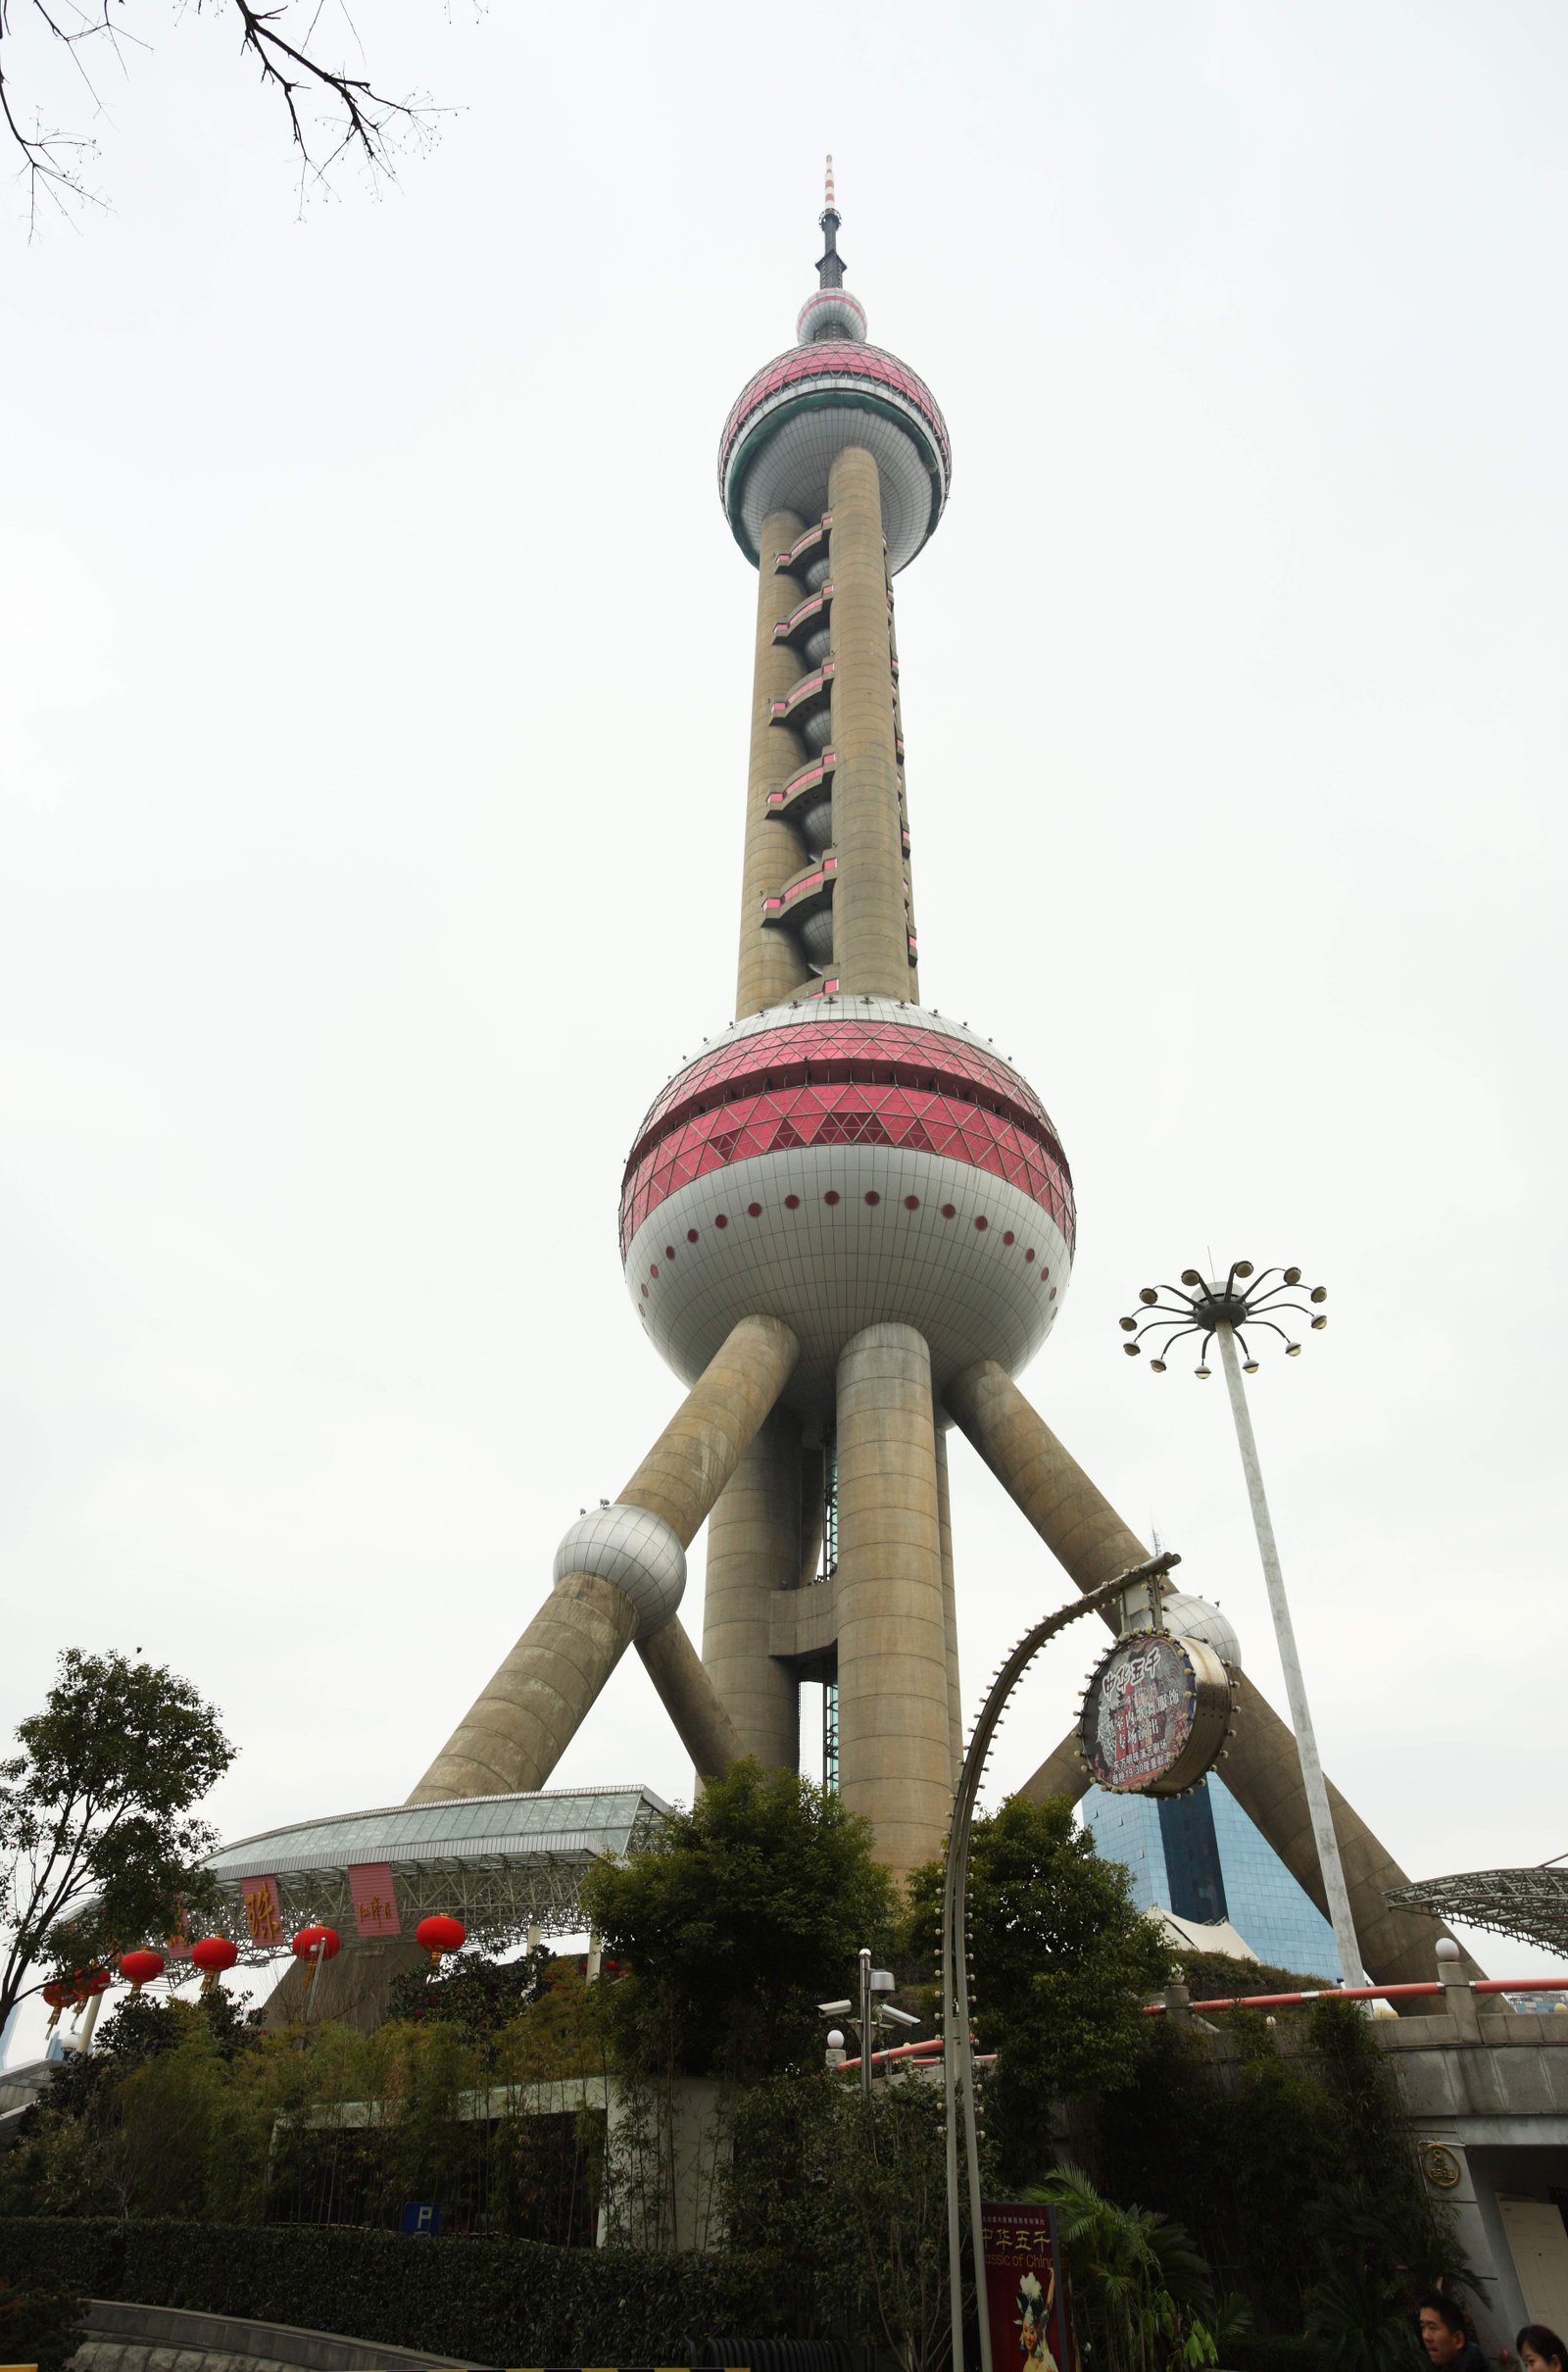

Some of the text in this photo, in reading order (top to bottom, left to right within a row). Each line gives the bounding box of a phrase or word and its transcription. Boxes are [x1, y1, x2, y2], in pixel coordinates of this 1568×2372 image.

[1102, 1647, 1161, 1702] 中华五千
[417, 2206, 432, 2229] P
[982, 2227, 1052, 2253] 中华五千
[985, 2253, 1010, 2266] assic
[1012, 2253, 1024, 2267] of
